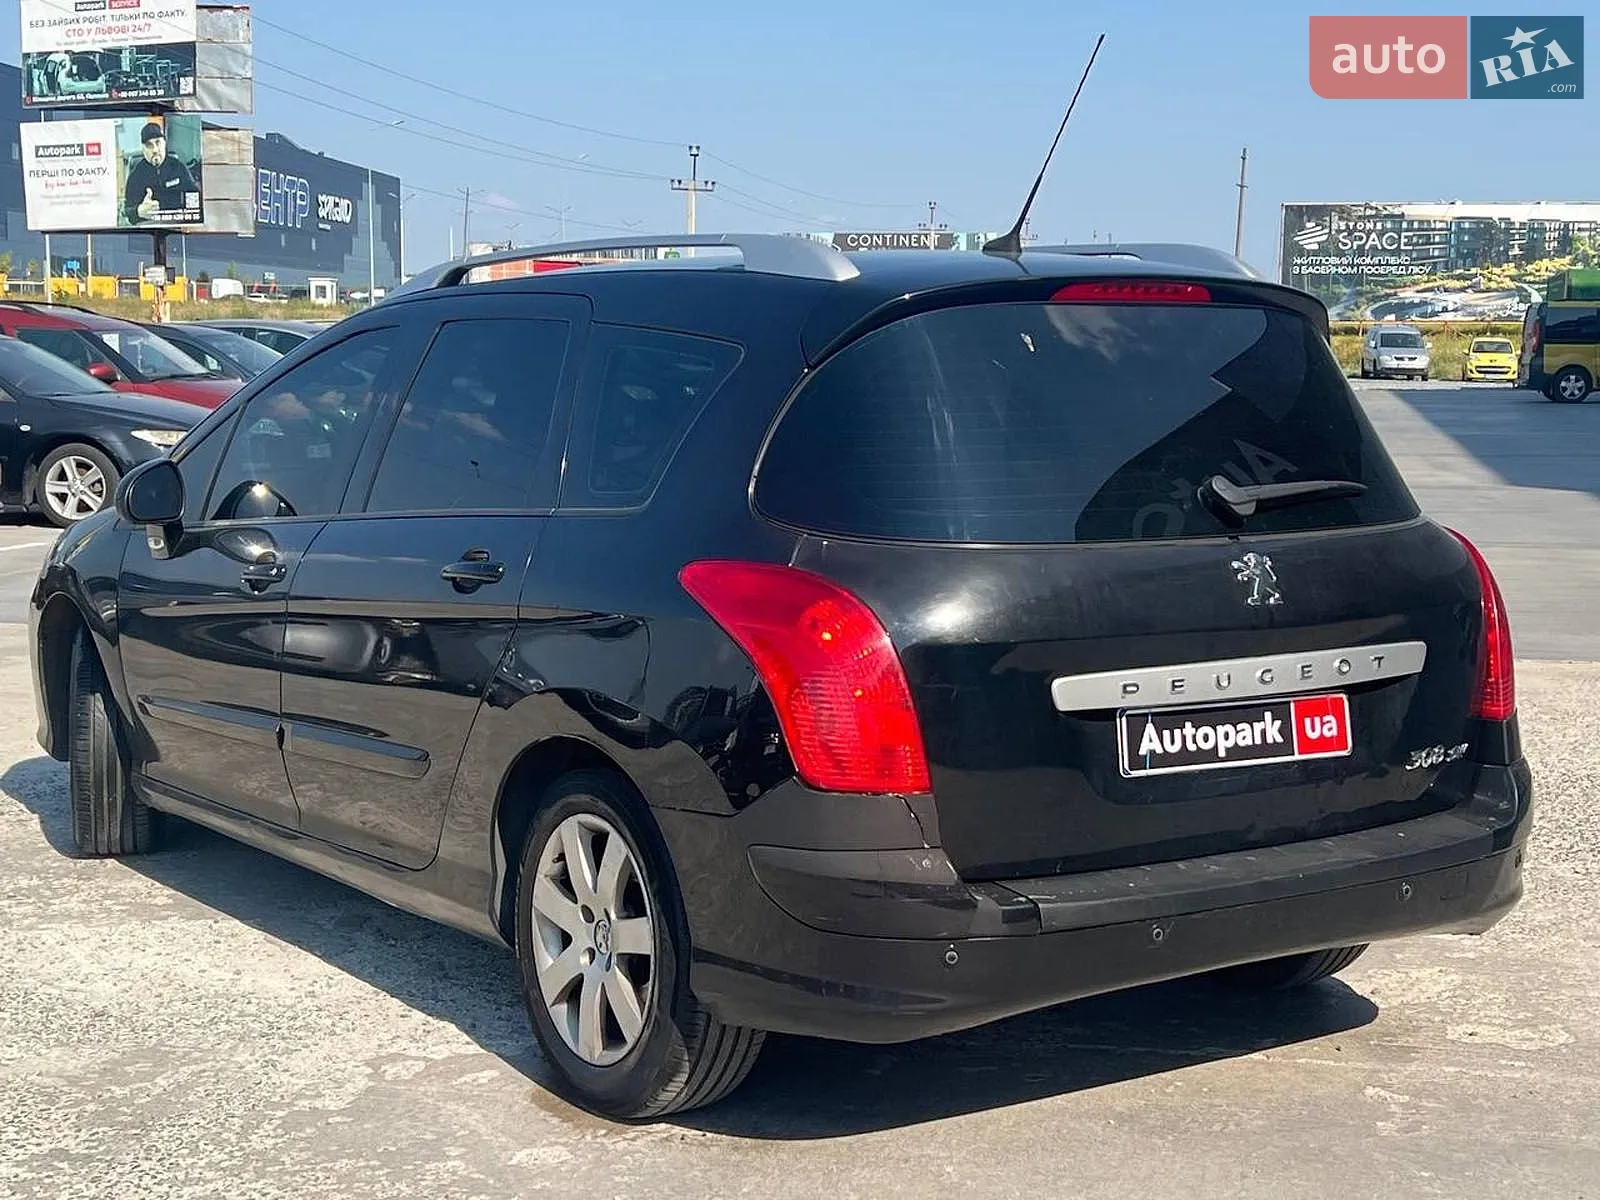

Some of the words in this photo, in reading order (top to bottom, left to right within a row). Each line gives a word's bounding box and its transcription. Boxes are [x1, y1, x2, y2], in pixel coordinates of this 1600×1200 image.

[65, 28, 83, 38] СТО
[131, 23, 152, 33] 24/7
[37, 145, 81, 157] Autopark
[29, 169, 59, 178] ПЕРШІ
[60, 168, 75, 177] ПО
[1338, 232, 1413, 250] SPACE
[1121, 655, 1385, 696] PEUGEOT
[1138, 711, 1284, 757] Autopark
[1304, 713, 1338, 741] ua
